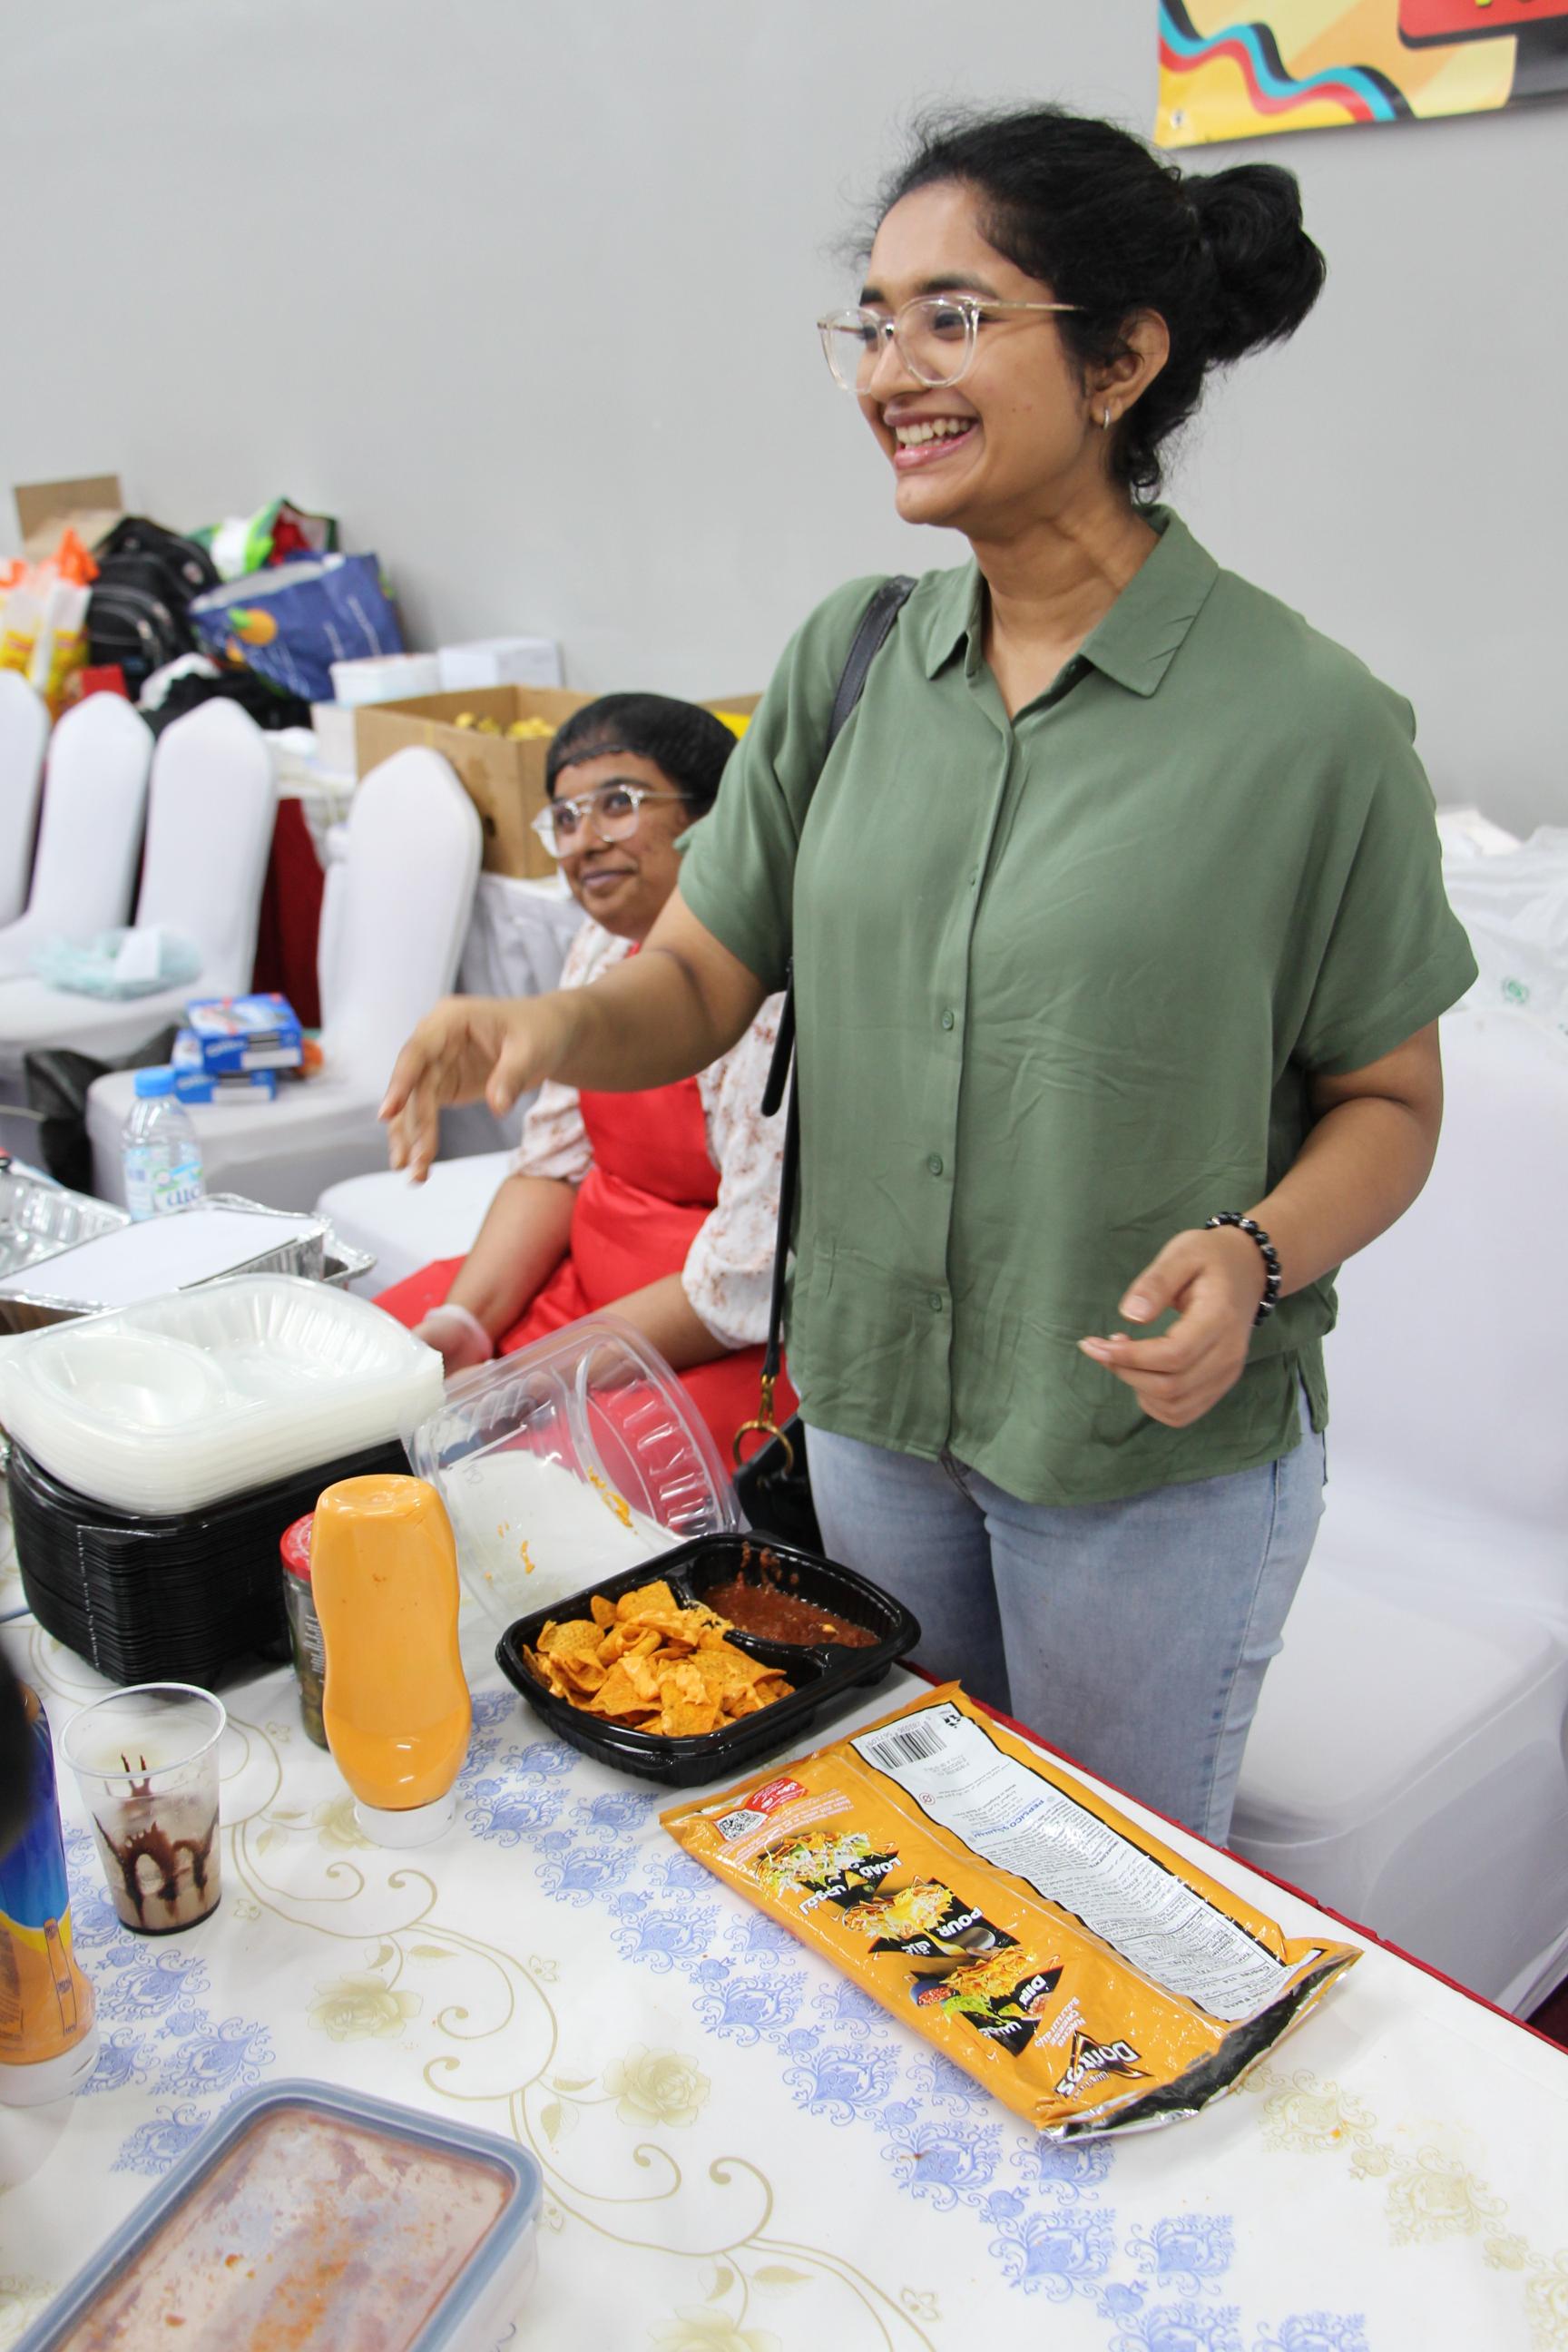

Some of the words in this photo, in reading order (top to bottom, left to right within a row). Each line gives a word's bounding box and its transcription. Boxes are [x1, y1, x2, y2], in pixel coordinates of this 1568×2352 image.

[1010, 1800, 1044, 1828] PEPSICO
[859, 1857, 902, 1877] LOAD
[936, 1906, 983, 1937] POUR
[1019, 1974, 1046, 2004] DIP
[1055, 2041, 1140, 2098] Doritos
